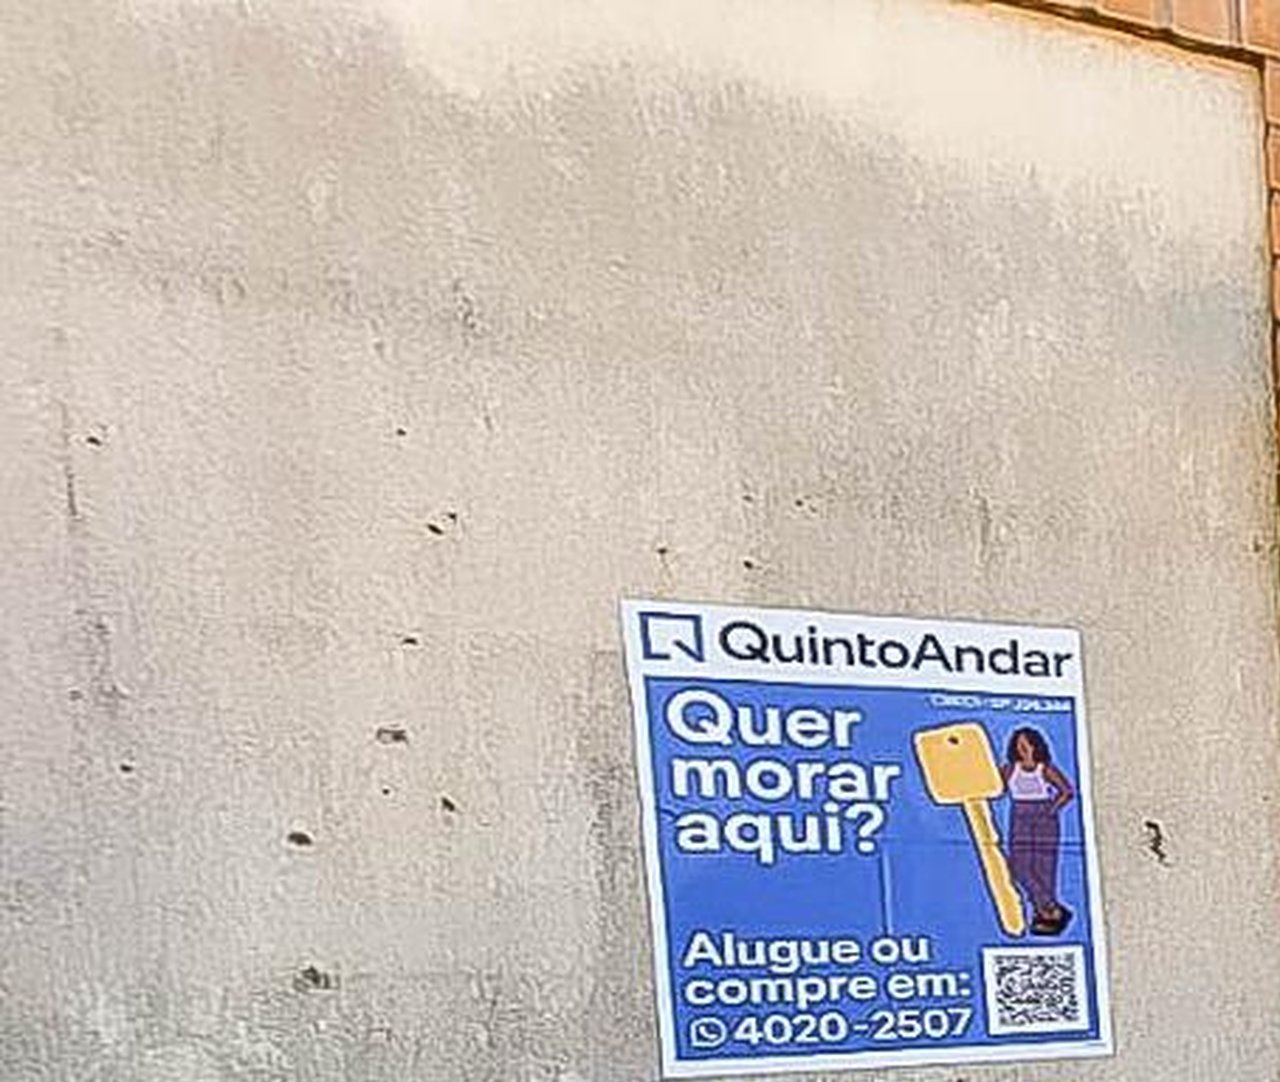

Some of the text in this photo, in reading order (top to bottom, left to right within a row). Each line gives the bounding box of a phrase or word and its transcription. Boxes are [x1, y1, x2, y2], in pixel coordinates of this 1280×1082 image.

[719, 620, 1073, 679] QuintoAndar
[666, 689, 862, 748] Quer
[672, 754, 899, 801] morar
[676, 803, 886, 864] aqui?
[684, 933, 929, 972] Alugue ou
[685, 971, 970, 1009] compre em:
[734, 1008, 972, 1044] 4020-2507
